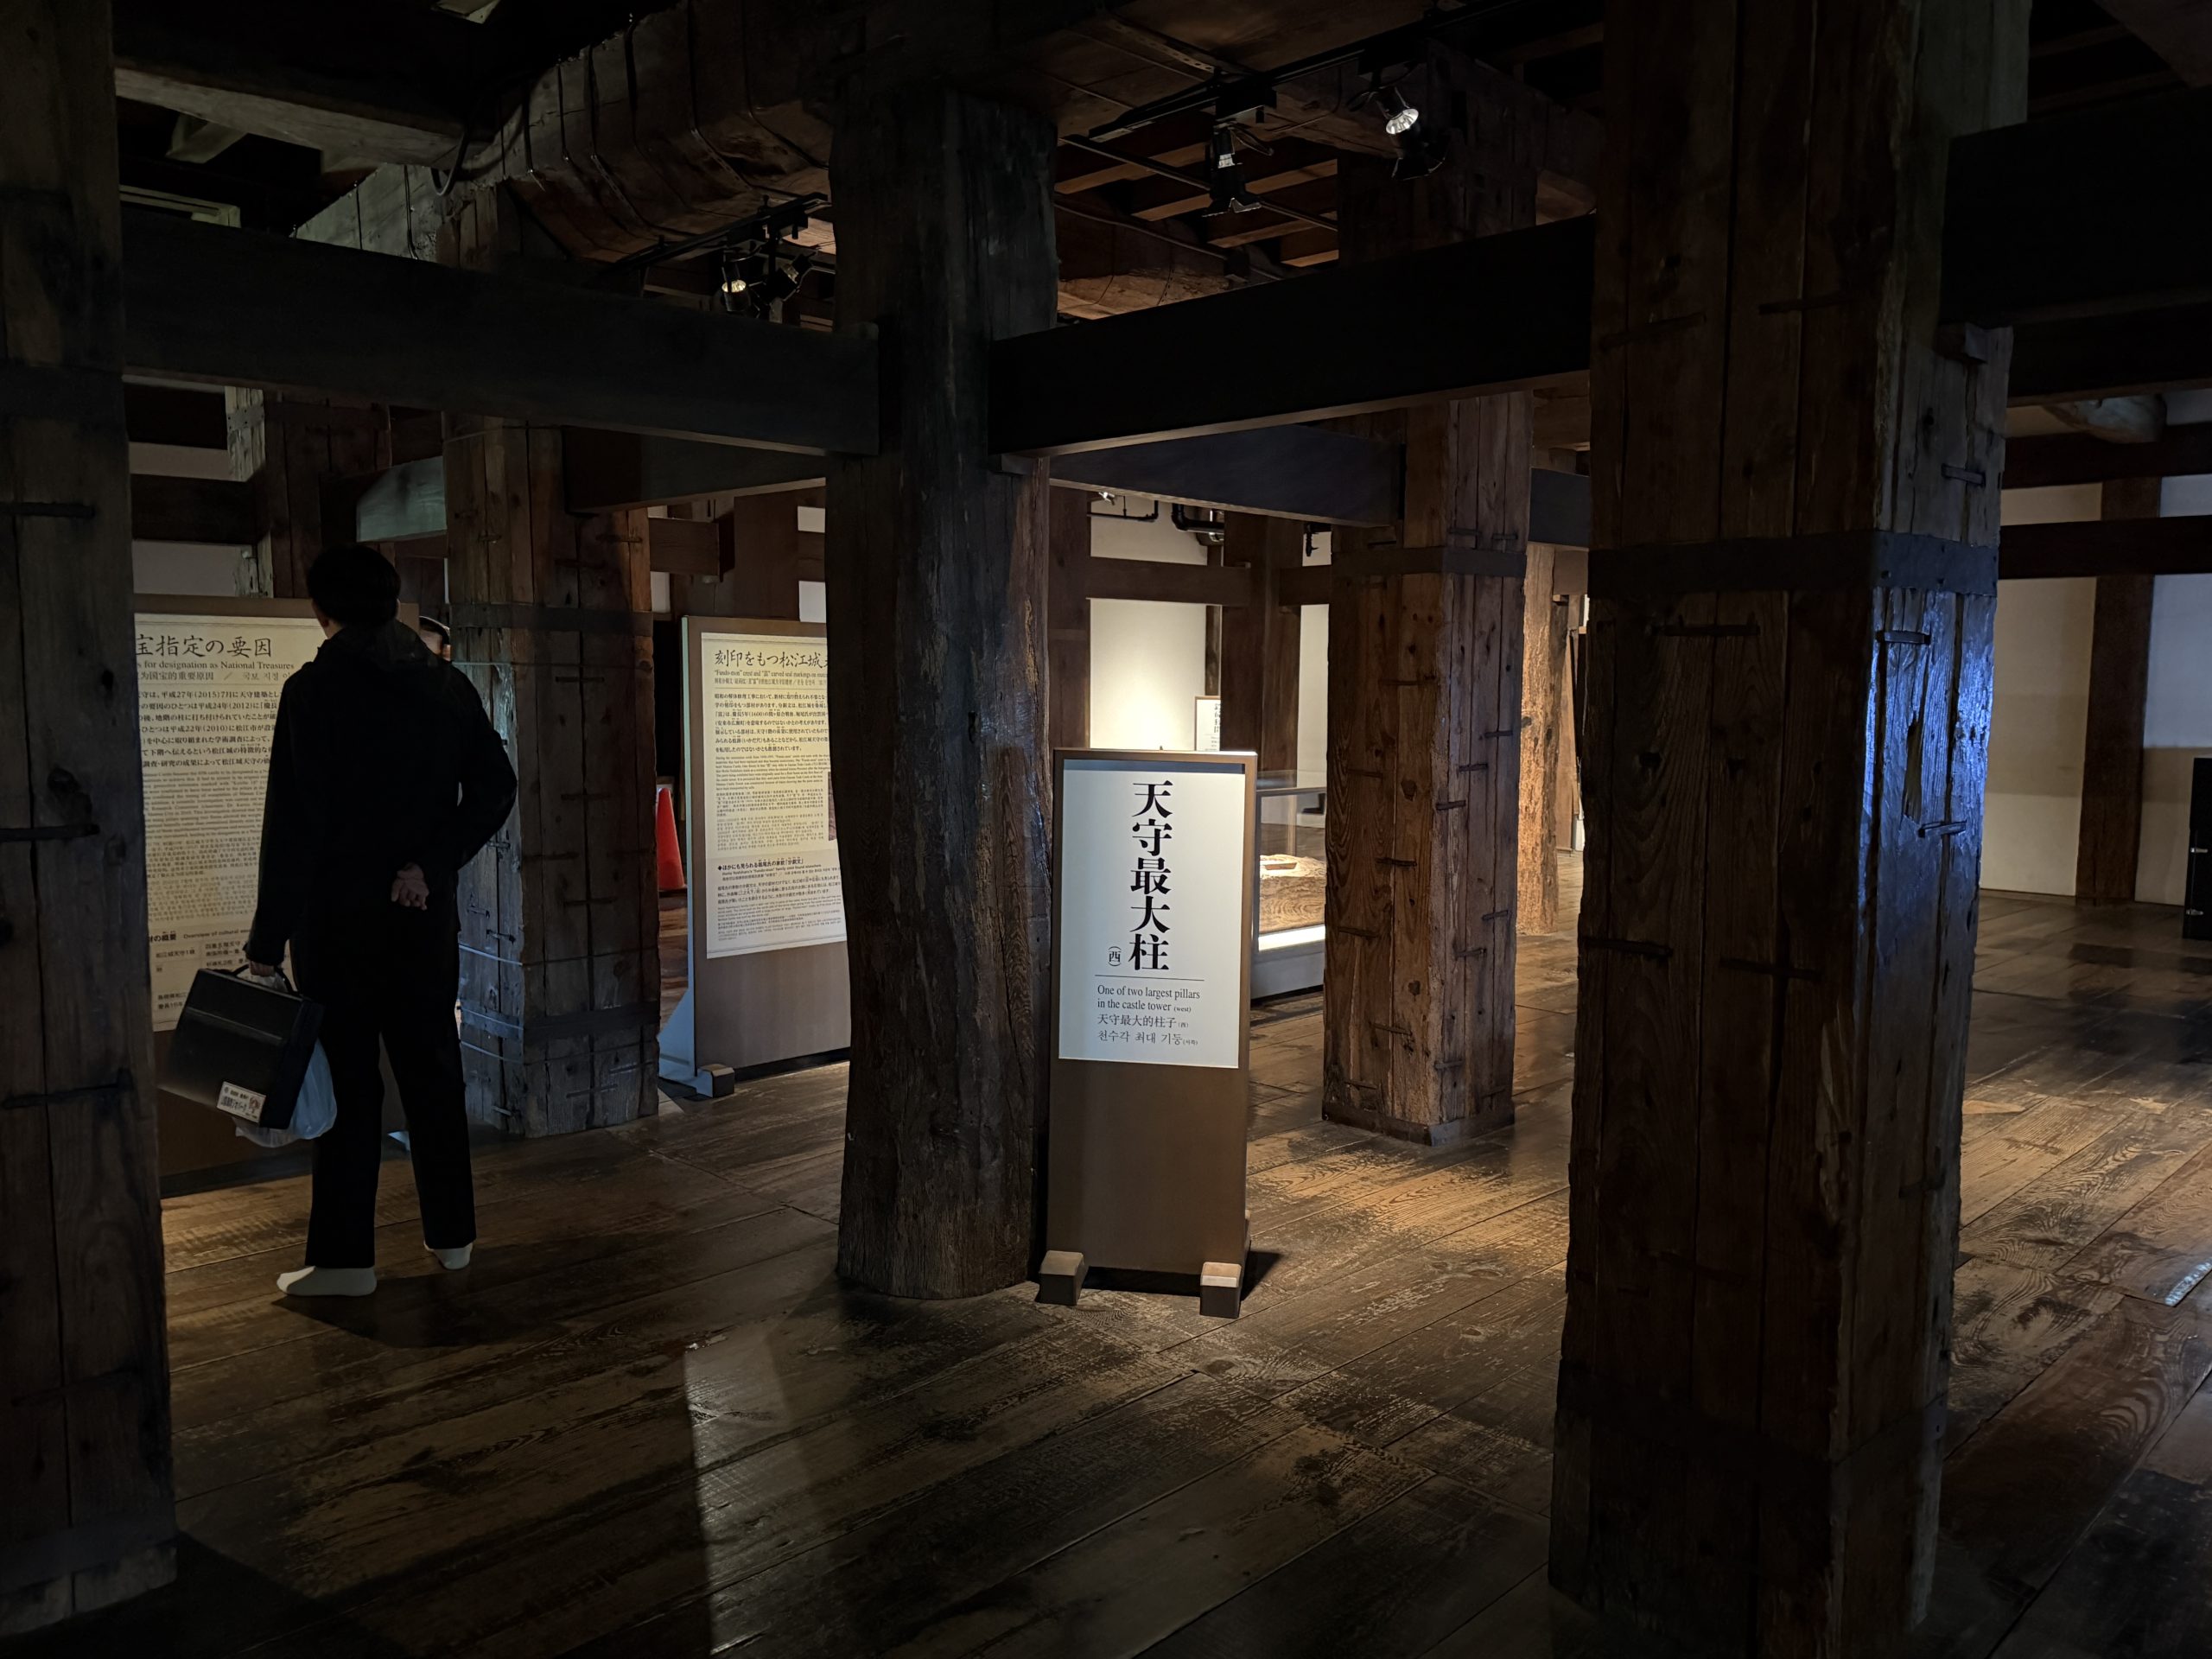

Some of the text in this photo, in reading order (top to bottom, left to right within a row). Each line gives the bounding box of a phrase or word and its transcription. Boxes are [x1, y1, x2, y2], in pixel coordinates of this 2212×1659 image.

[136, 633, 272, 658] 宝指定の要因
[159, 661, 207, 671] designation
[220, 661, 255, 670] National
[257, 661, 295, 670] Treasures
[715, 649, 828, 668] 刻印をもつ松江城
[138, 671, 214, 681] 为国宝的重要原因
[1128, 780, 1173, 971] 天守最大柱
[1097, 984, 1200, 1001] One of two largest pillars
[1097, 998, 1105, 1008] in
[1108, 999, 1120, 1009] the
[1122, 1000, 1146, 1010] castle
[1147, 1001, 1172, 1011] tower
[1098, 1030, 1130, 1043] 천수각
[1135, 1032, 1155, 1044] 최대
